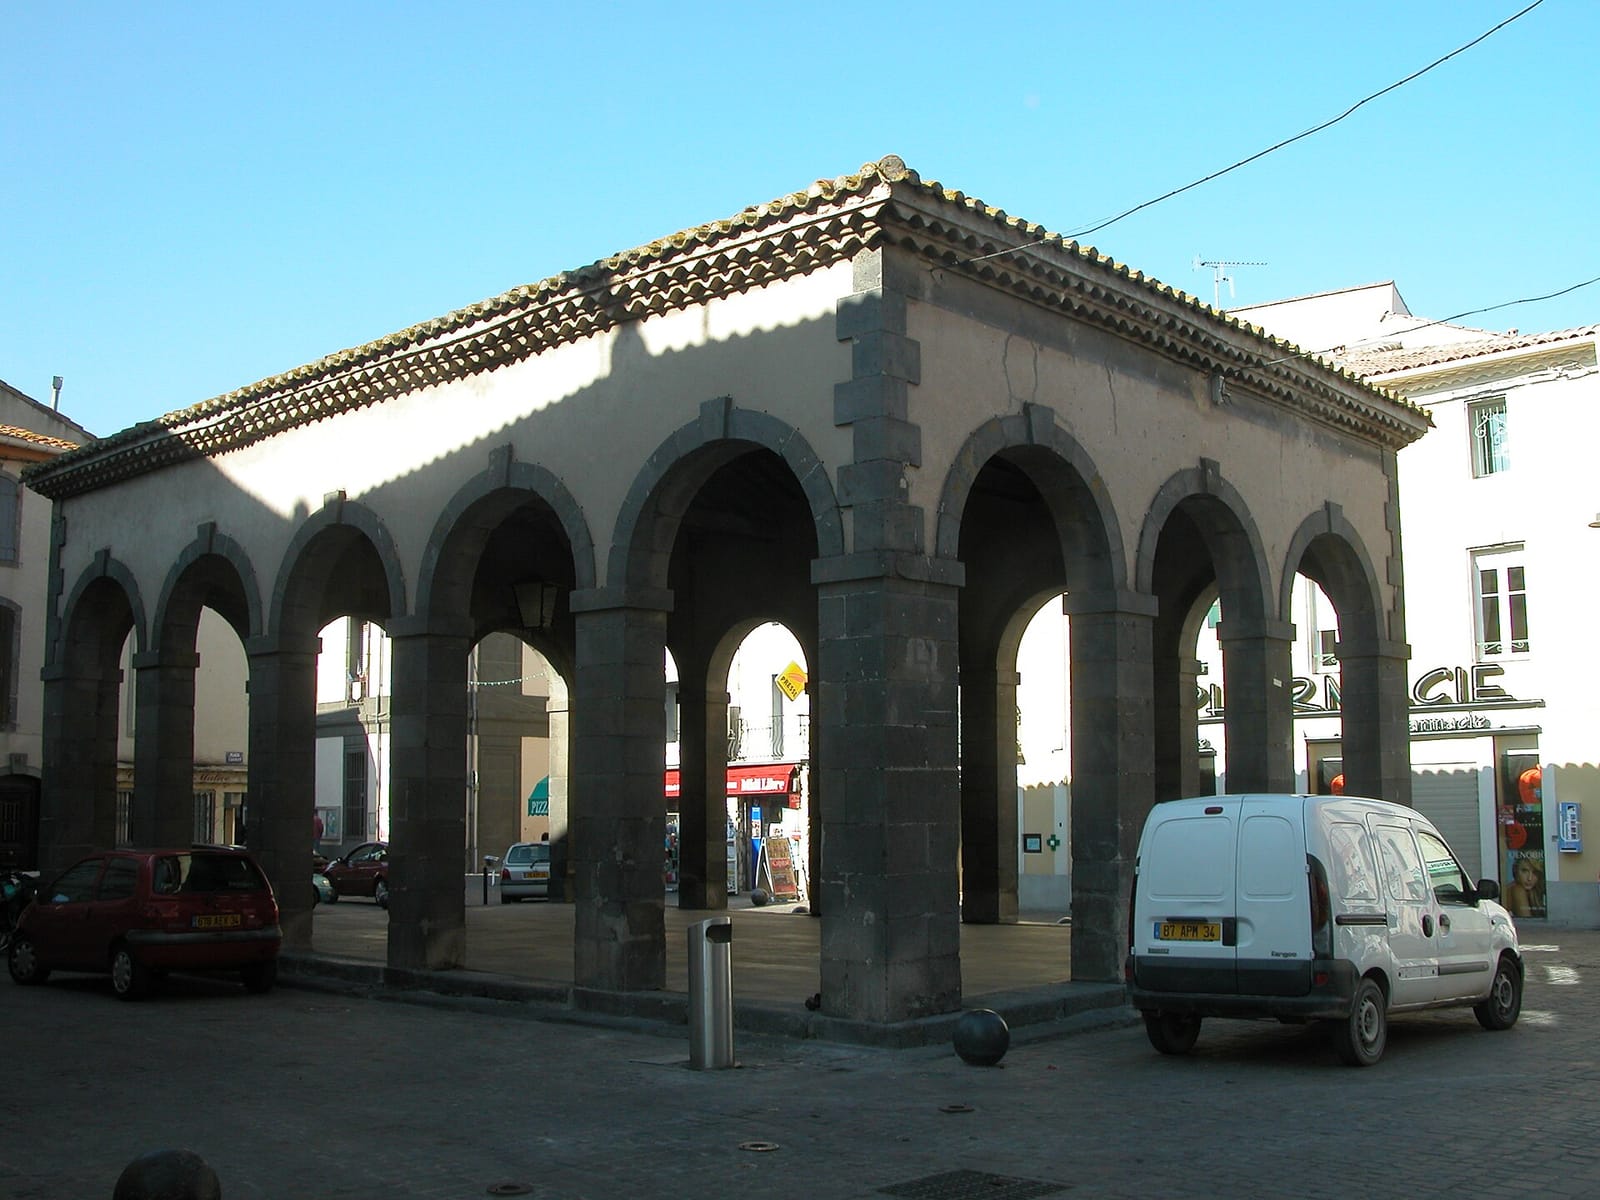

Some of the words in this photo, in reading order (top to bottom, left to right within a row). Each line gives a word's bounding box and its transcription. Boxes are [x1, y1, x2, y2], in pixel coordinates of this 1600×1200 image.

[780, 675, 797, 698] PRESSE
[1409, 712, 1489, 731] armacie
[531, 800, 548, 814] PIZZ
[1163, 925, 1175, 937] 87
[1181, 925, 1198, 938] APM
[1203, 926, 1215, 938] 34
